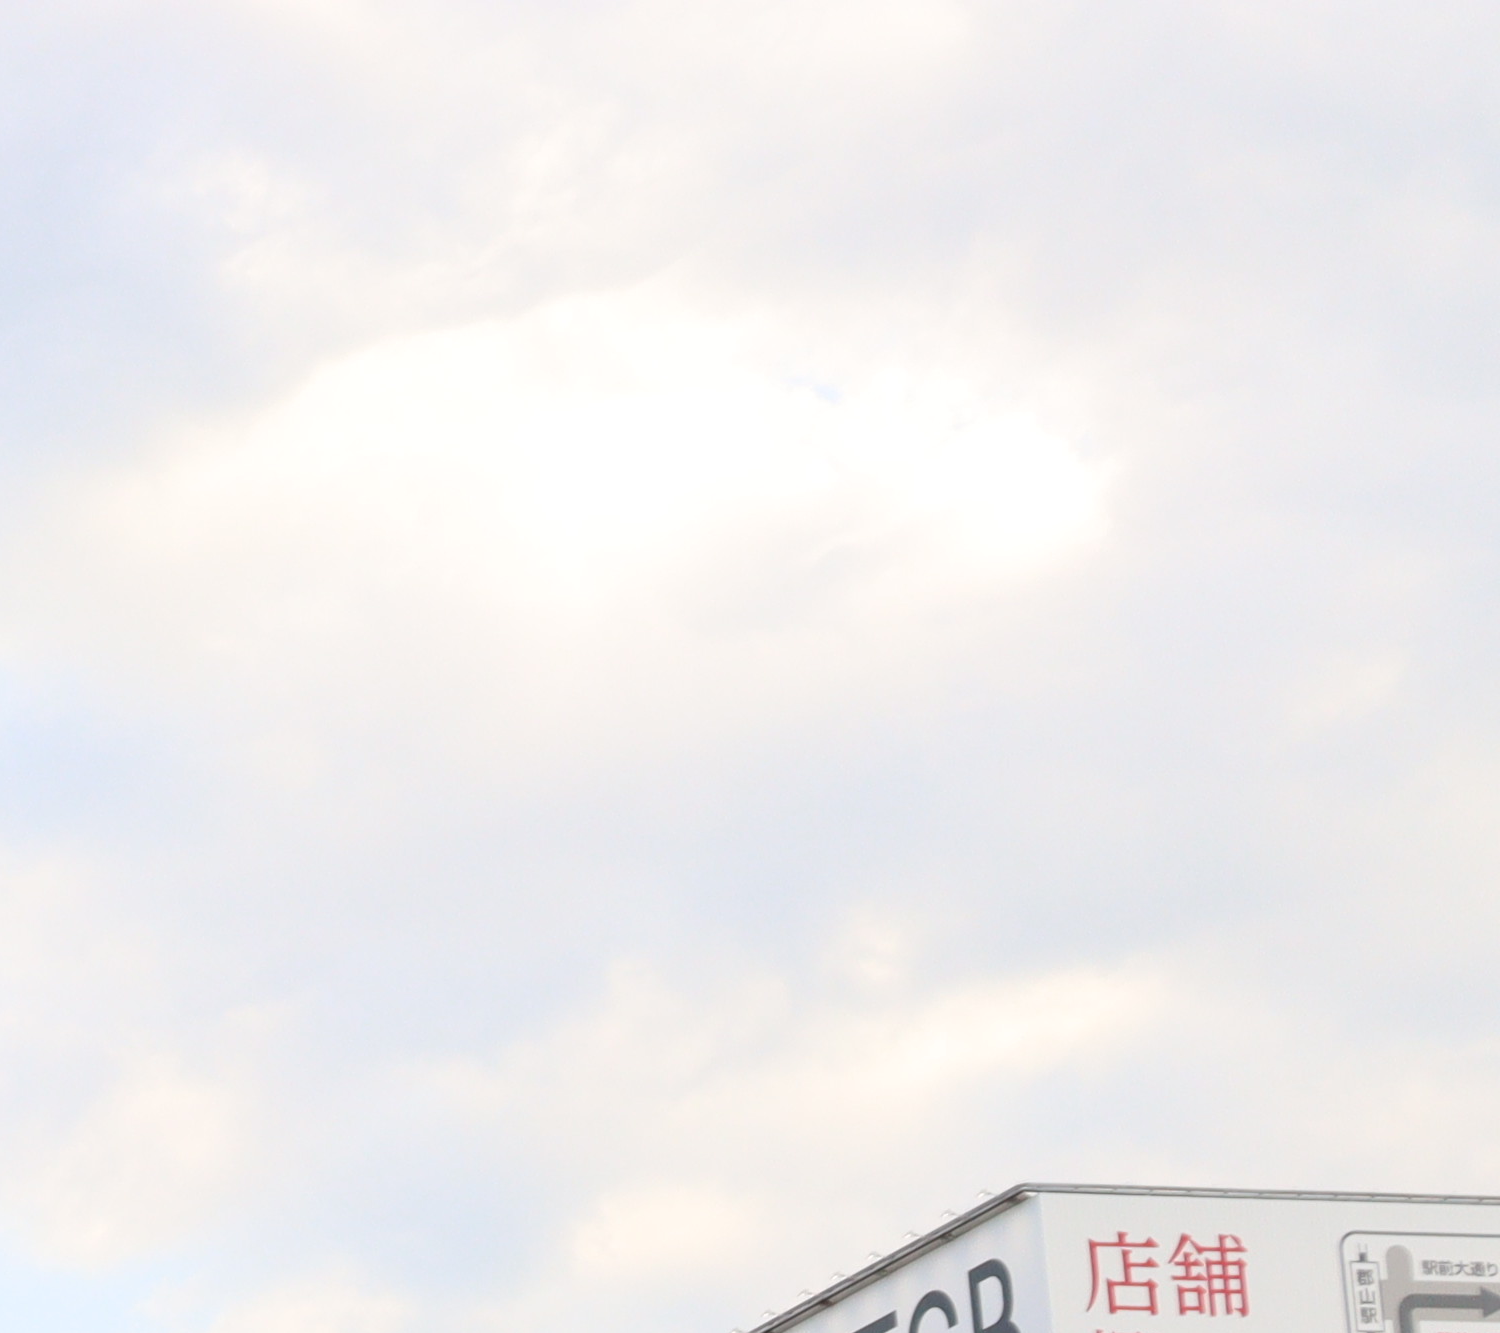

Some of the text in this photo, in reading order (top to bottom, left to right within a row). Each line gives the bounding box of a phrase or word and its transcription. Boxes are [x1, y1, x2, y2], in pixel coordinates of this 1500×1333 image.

[1085, 1231, 1250, 1317] 店舗
[1356, 1268, 1379, 1325] 郡山駅
[1422, 1259, 1499, 1277] 駅前大通り
